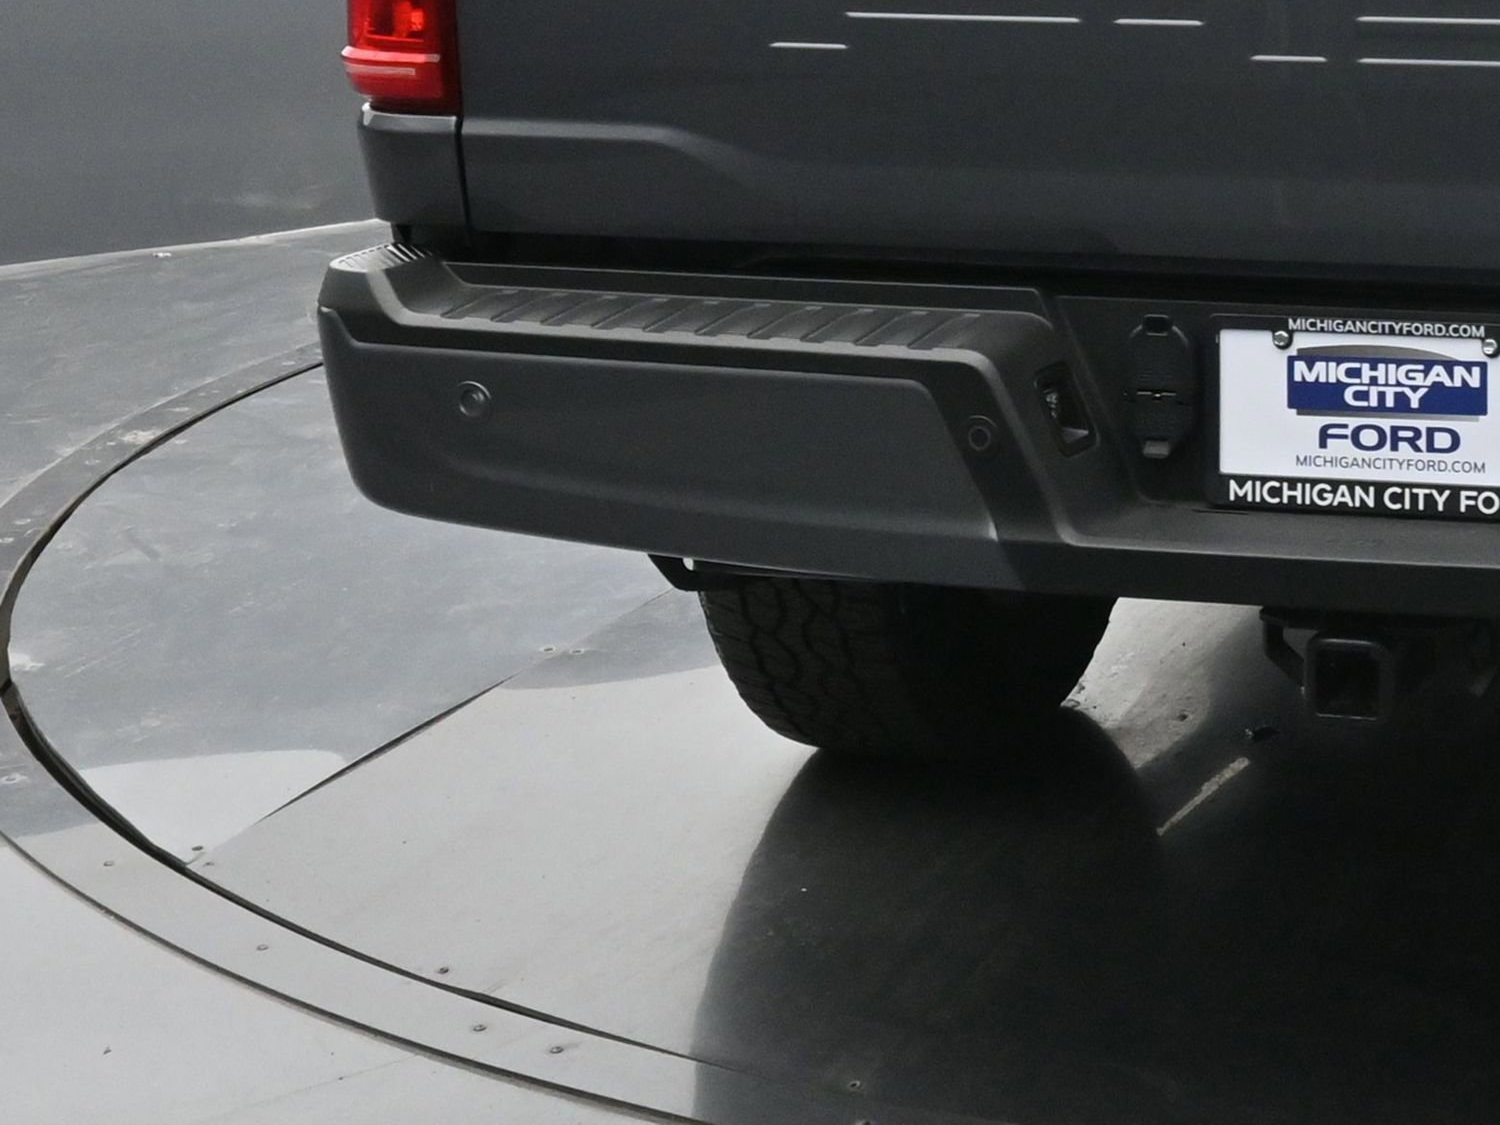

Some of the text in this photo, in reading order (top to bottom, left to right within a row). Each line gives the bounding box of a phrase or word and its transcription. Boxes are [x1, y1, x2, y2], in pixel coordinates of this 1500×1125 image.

[1287, 317, 1486, 339] MICHIGANCITYFORD.COM
[1293, 360, 1481, 388] MICHIGAN
[1343, 384, 1429, 409] CITY
[1318, 422, 1461, 454] FORD
[1295, 454, 1486, 474] MICHIGANCITYFORD.COM
[1228, 478, 1376, 509] MICHIGAN
[1382, 486, 1451, 512] CITY
